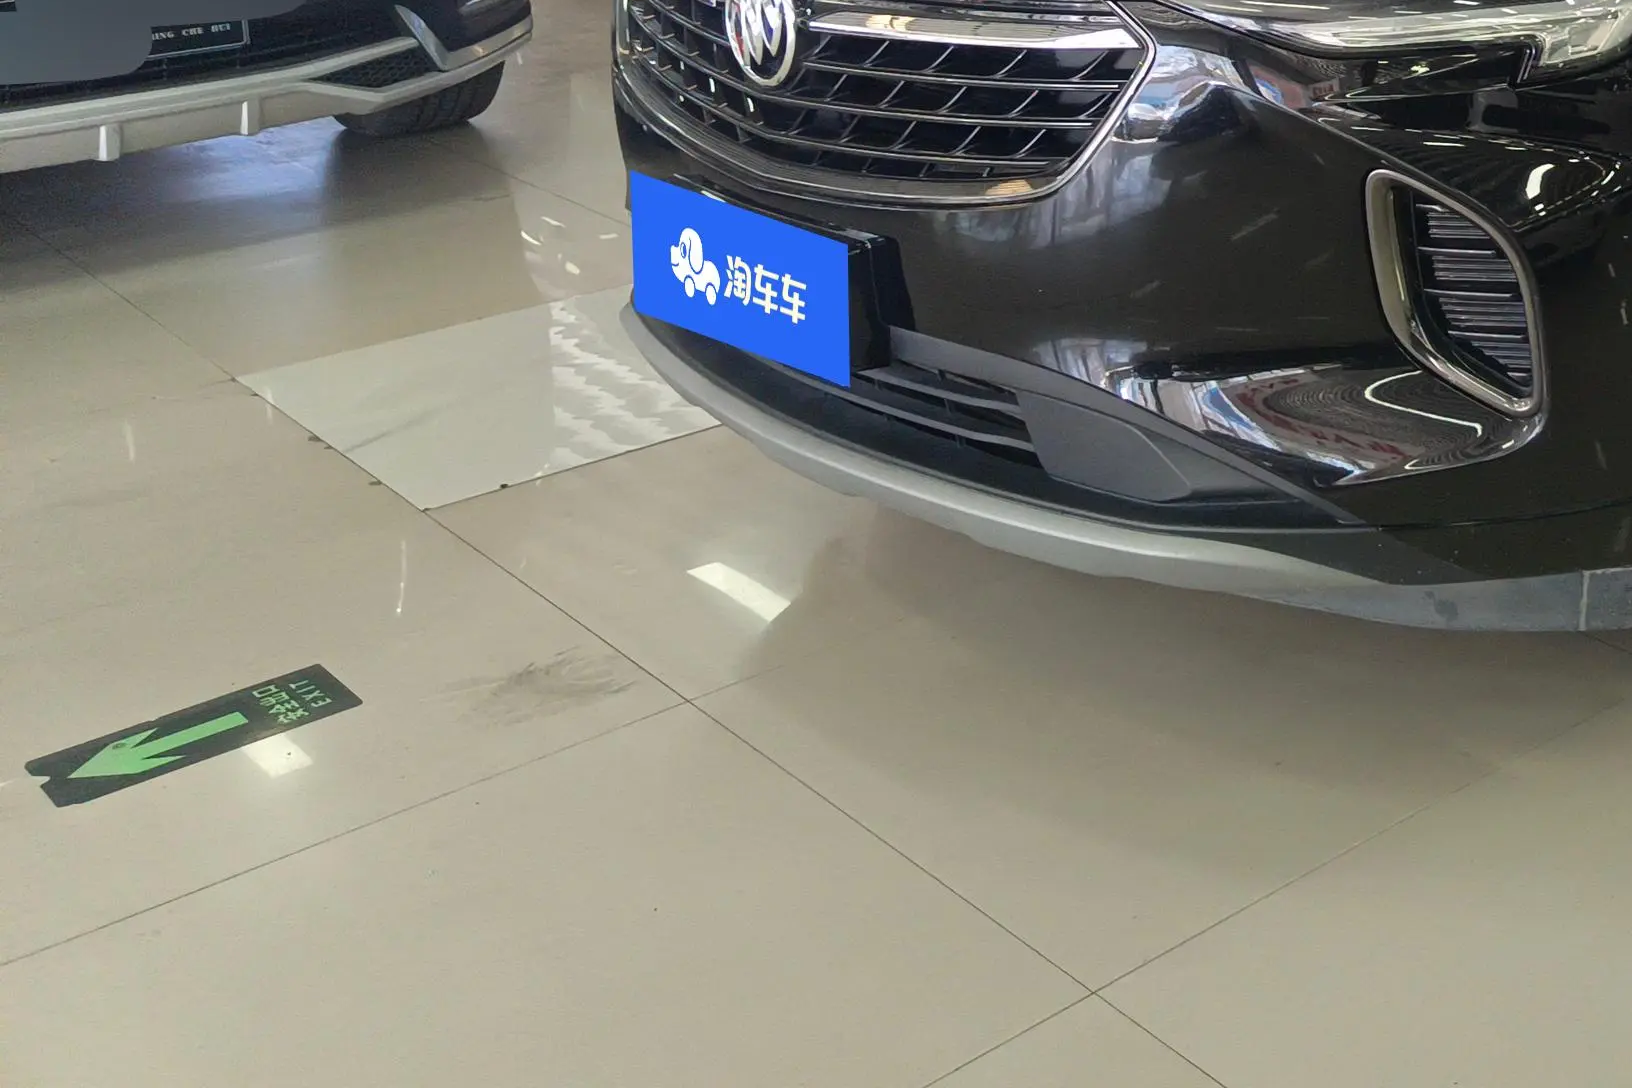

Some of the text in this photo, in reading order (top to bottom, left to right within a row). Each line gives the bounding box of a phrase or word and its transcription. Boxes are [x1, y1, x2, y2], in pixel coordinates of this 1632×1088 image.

[251, 684, 310, 724] 安全出口
[288, 679, 333, 708] EXIT
